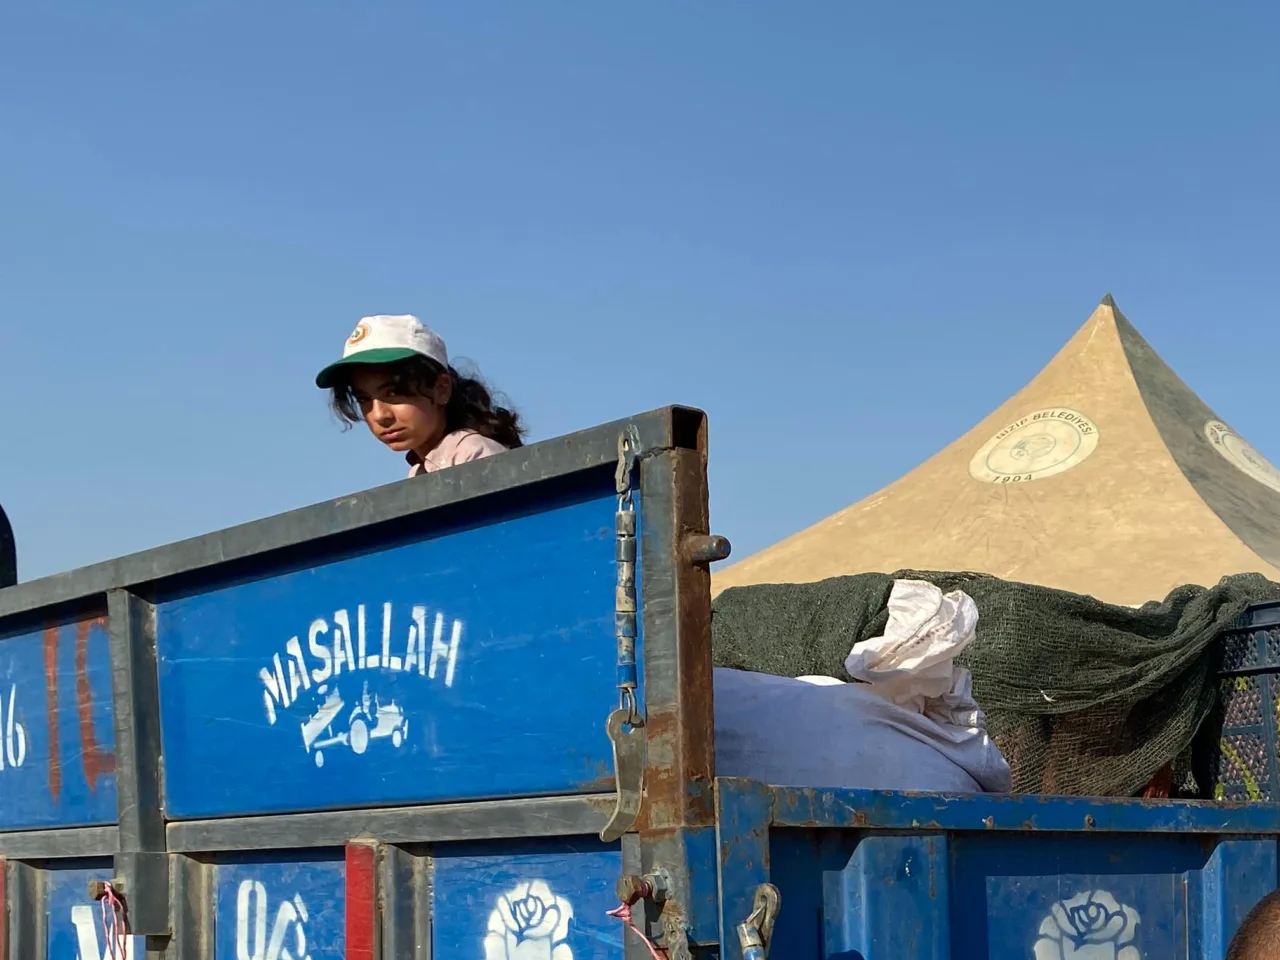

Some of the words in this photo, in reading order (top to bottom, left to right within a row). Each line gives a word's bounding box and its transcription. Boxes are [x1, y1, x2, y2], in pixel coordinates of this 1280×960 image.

[1032, 411, 1094, 436] BELEDİYESİ
[992, 474, 1032, 484] 1904
[259, 602, 462, 726] MASALLAH
